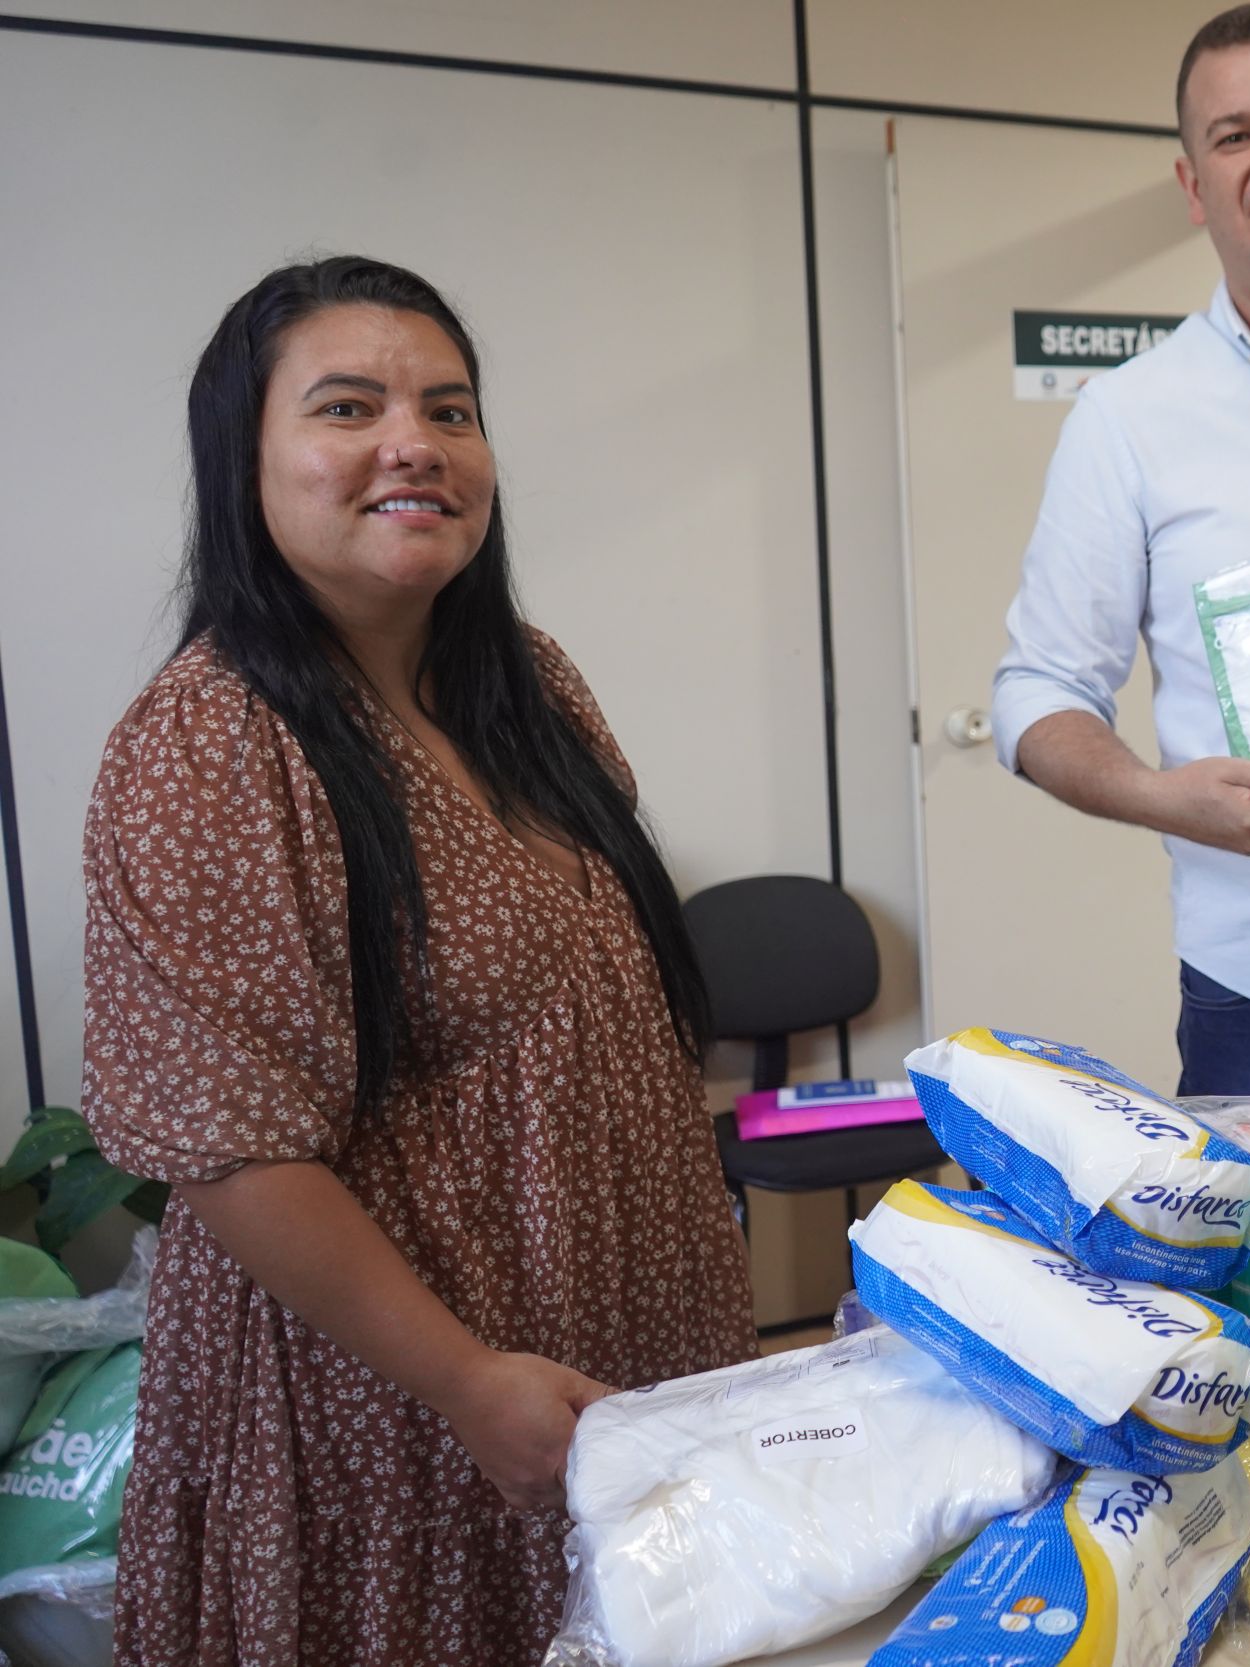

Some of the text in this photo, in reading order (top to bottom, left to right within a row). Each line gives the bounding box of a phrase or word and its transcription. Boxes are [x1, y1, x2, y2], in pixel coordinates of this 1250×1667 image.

[1040, 321, 1174, 356] SECRETÁR
[760, 1424, 856, 1448] COBERTOR
[0, 1466, 79, 1502] aúcha
